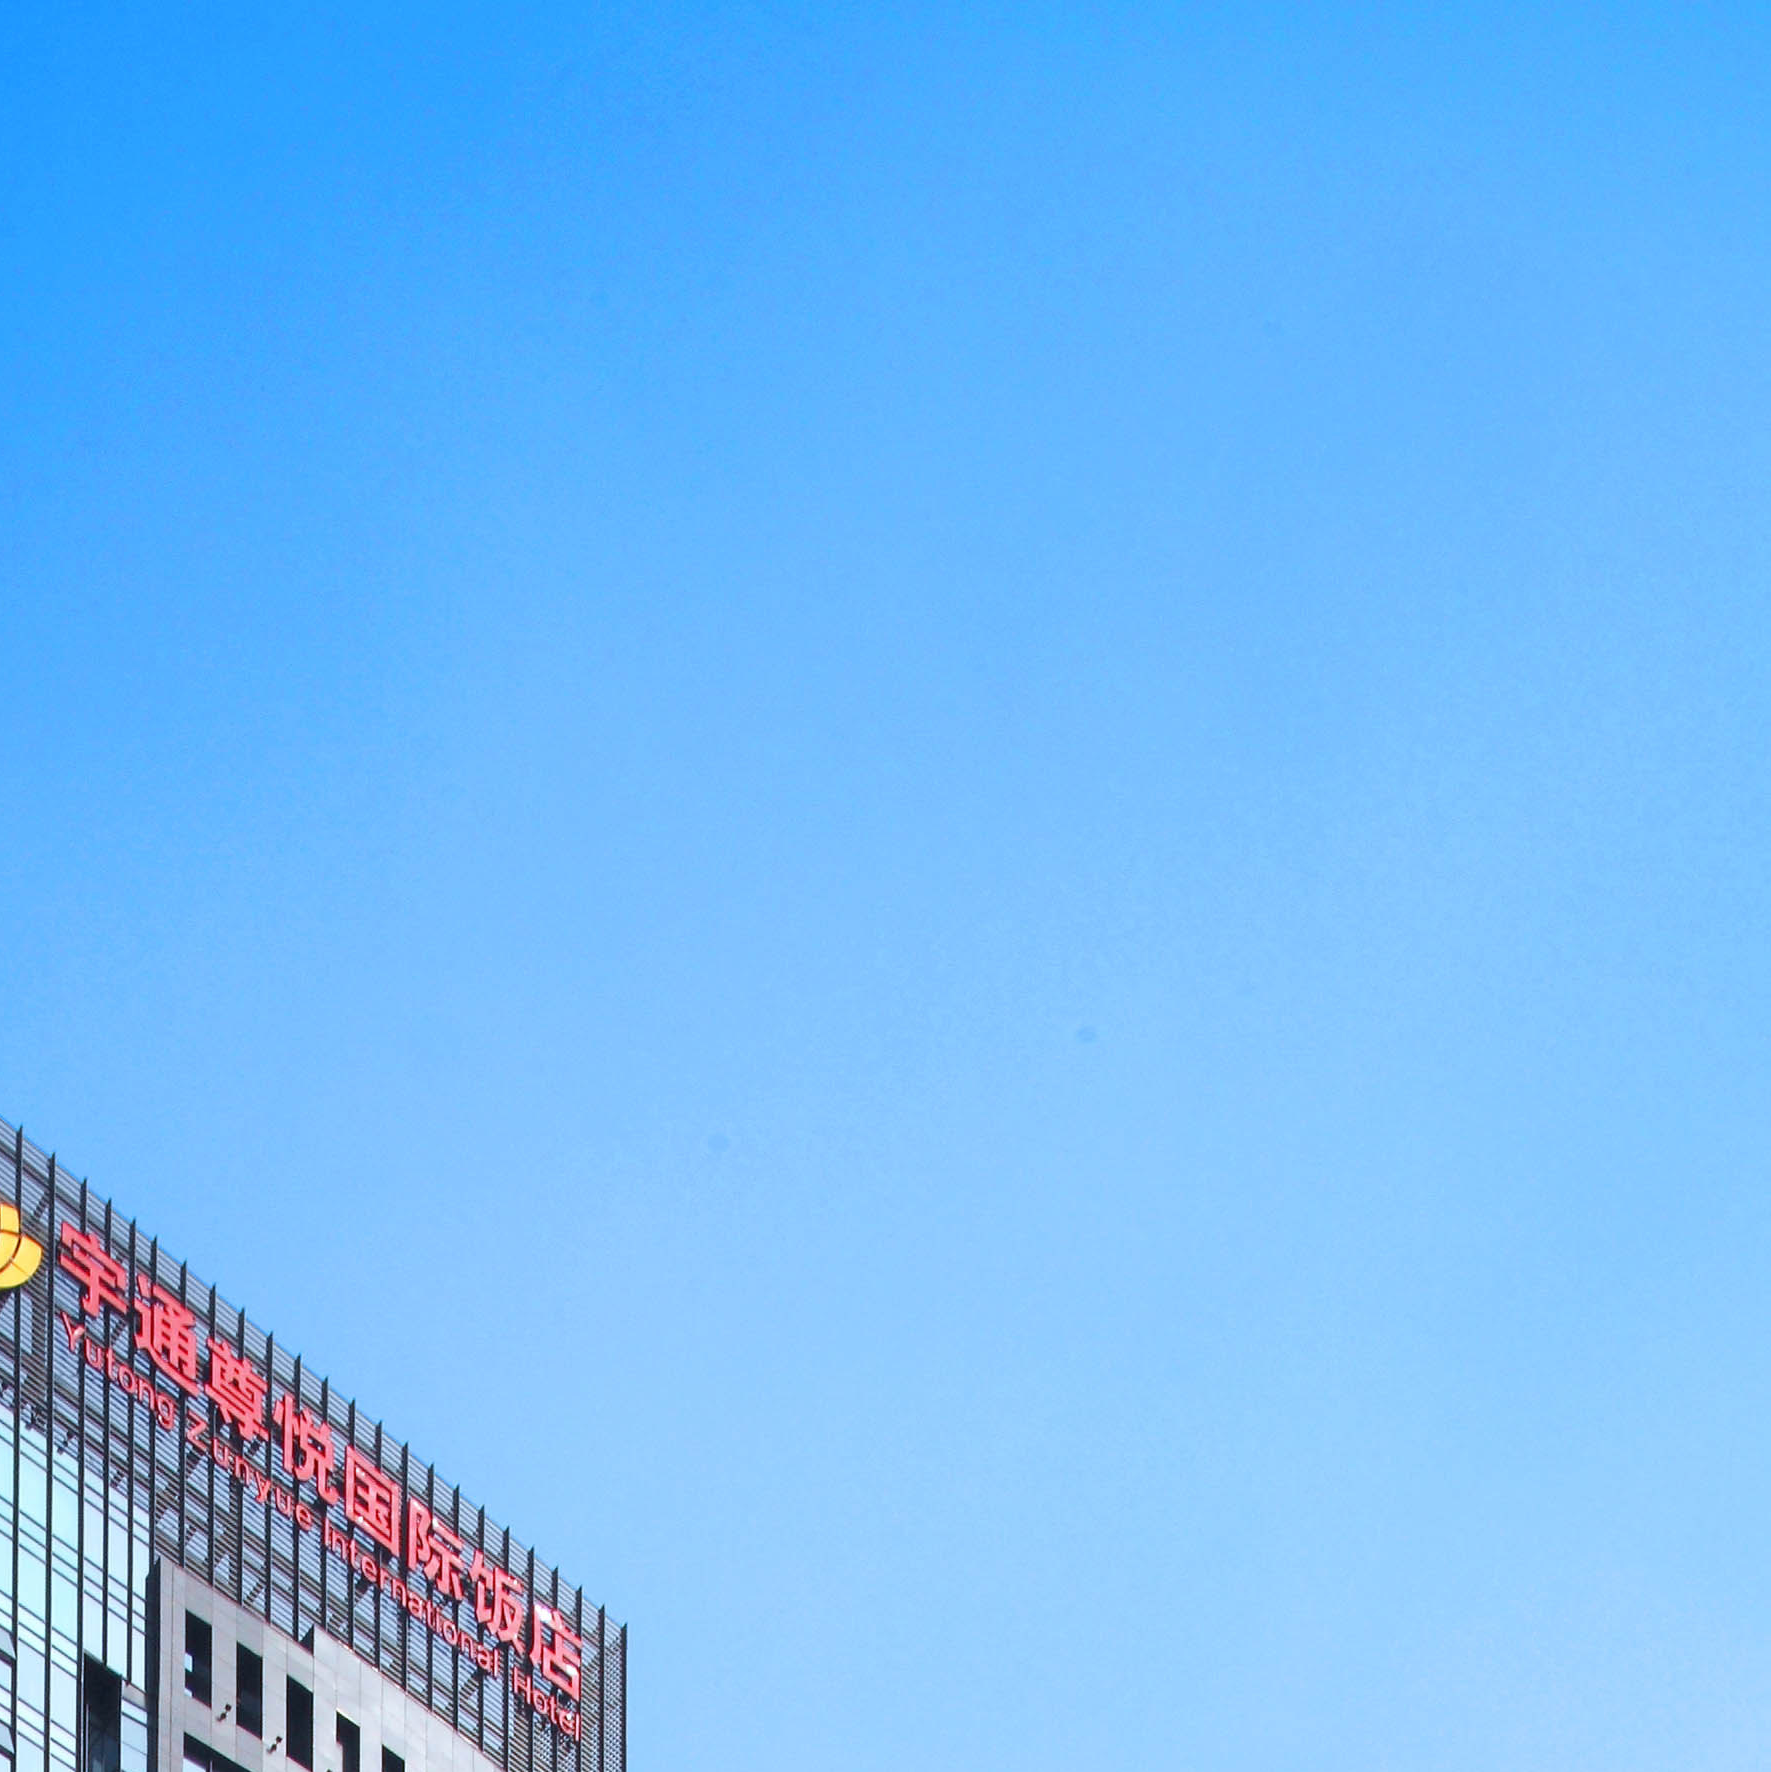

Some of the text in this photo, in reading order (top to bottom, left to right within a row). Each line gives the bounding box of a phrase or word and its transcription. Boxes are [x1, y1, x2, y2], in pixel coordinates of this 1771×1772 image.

[59, 1221, 583, 1702] 宇通尊悦国际饭店
[60, 1310, 580, 1742] Yutong Zunyue International Hotel
